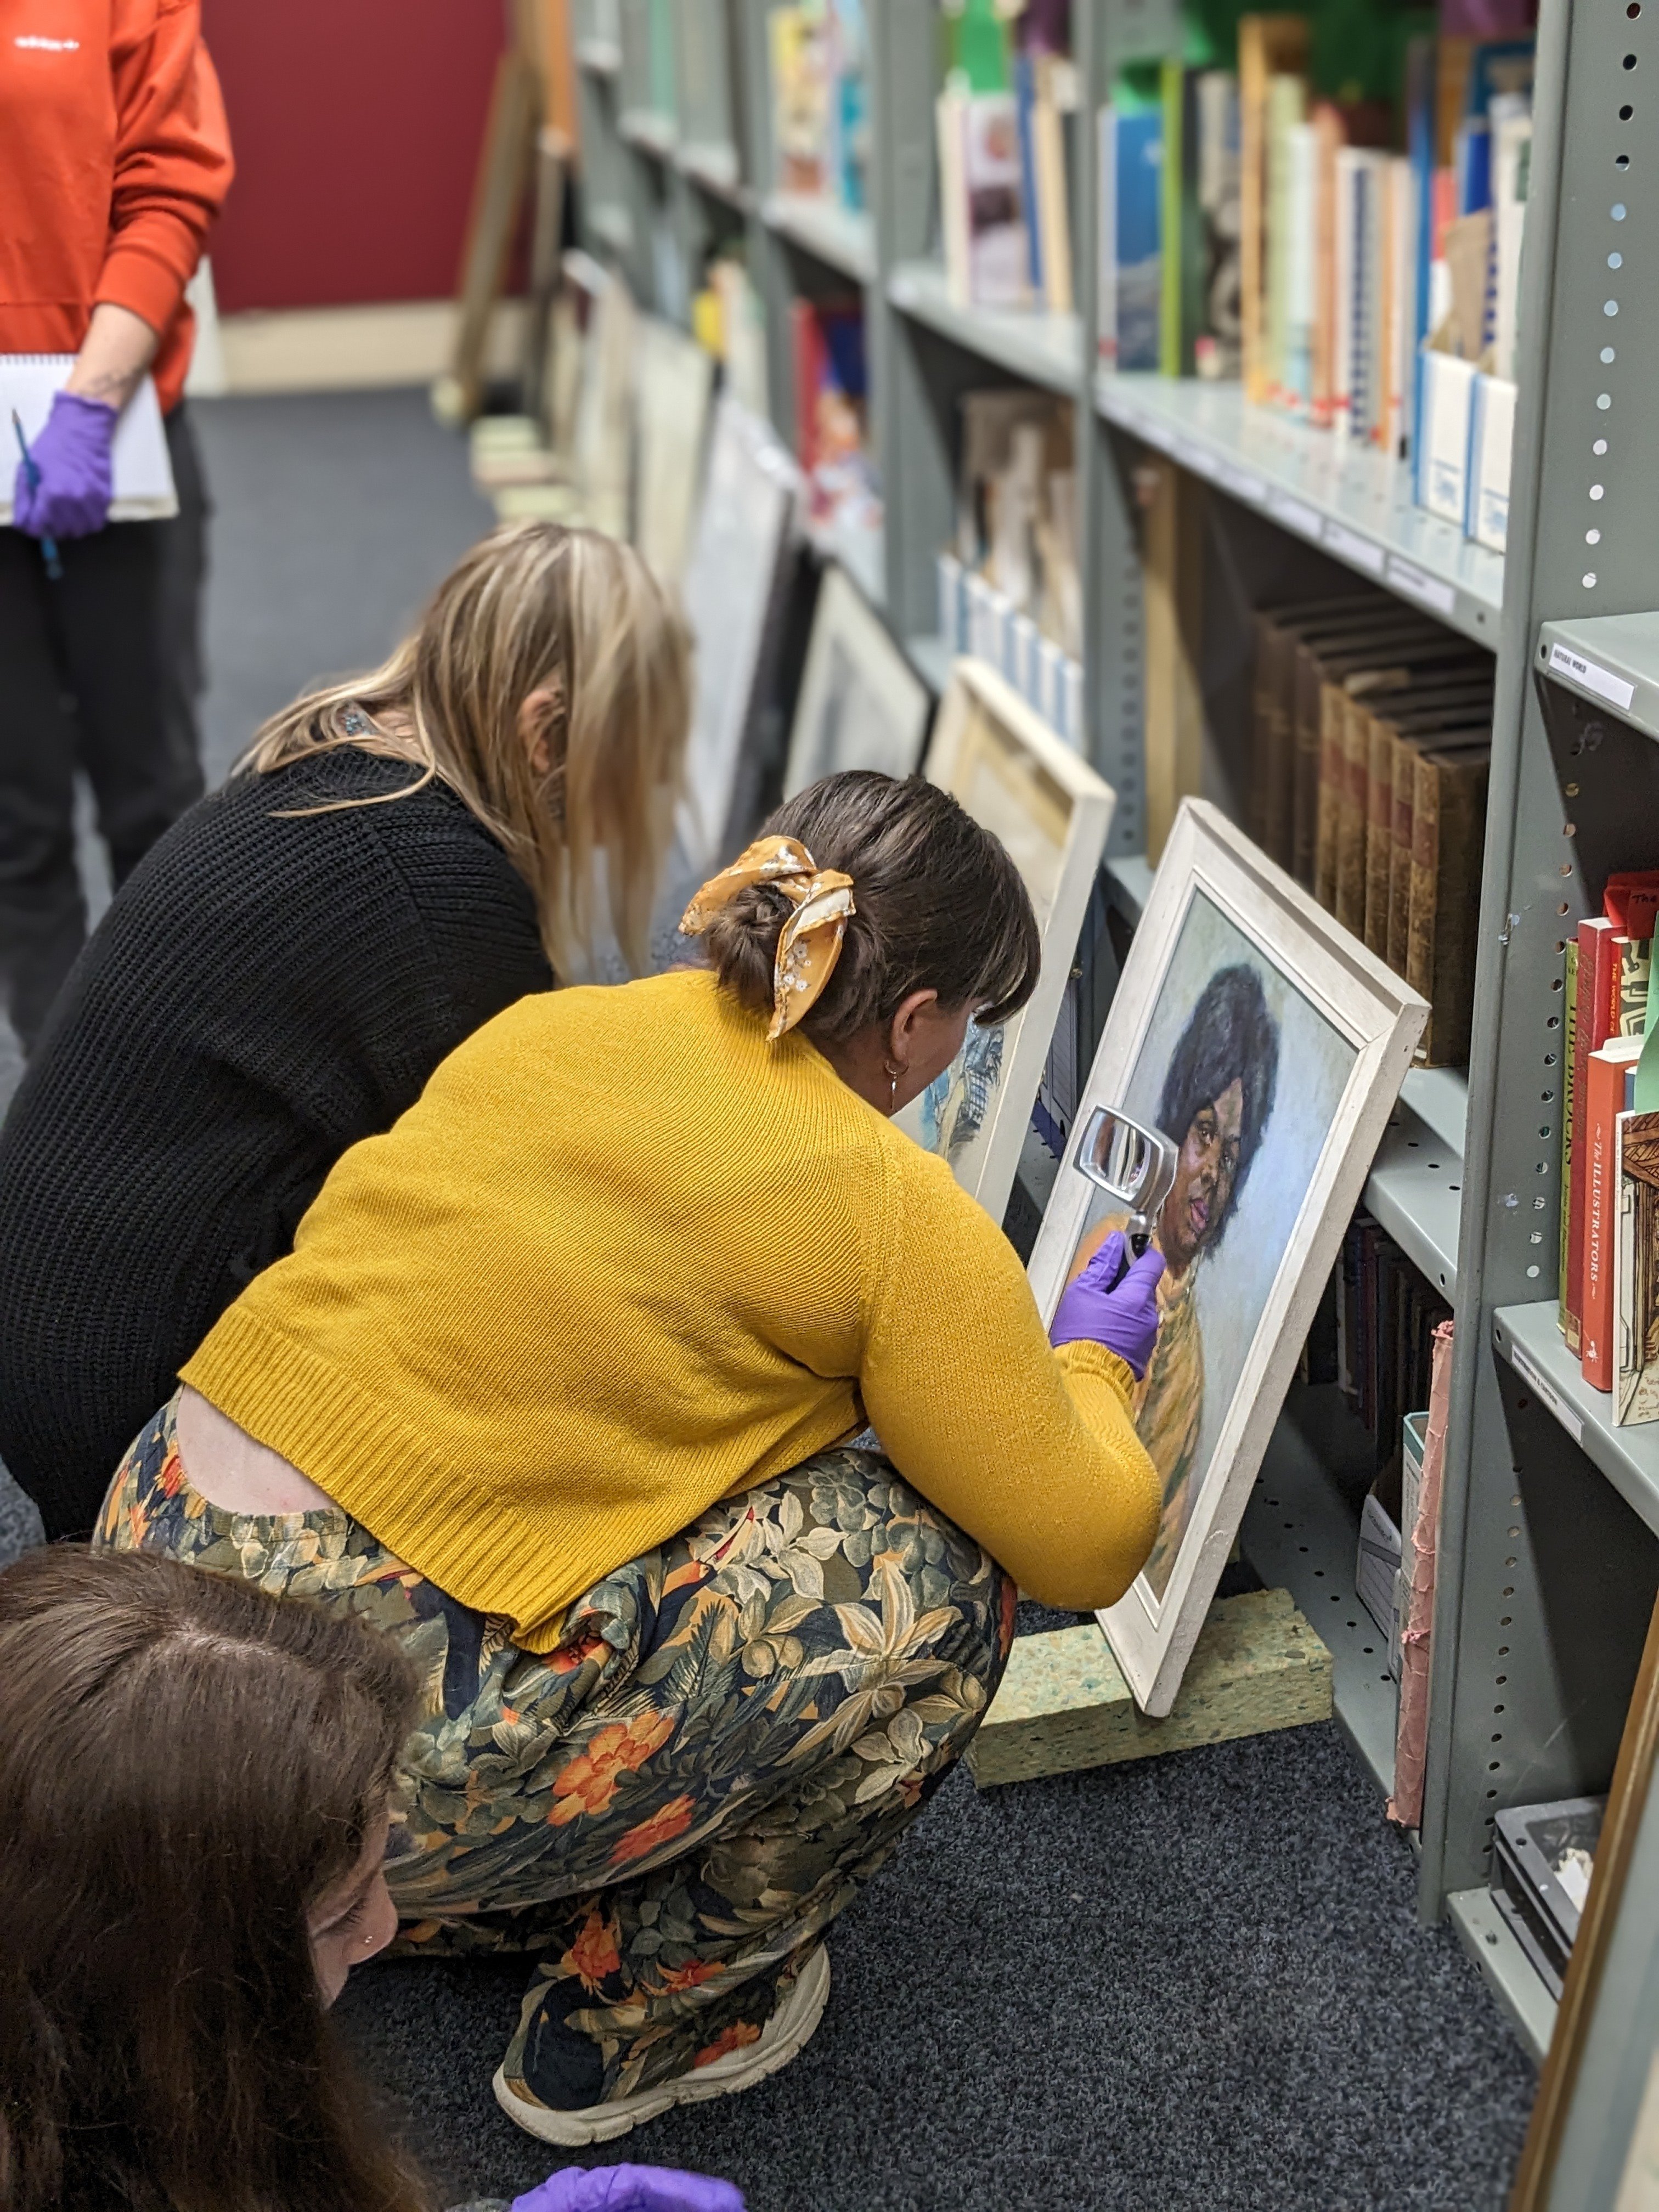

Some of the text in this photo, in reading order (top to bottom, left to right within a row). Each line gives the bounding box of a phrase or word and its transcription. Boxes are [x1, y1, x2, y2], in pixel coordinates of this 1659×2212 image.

[1572, 660, 1587, 674] WORLD
[1590, 1141, 1602, 1282] The ILLUSTRATORS
